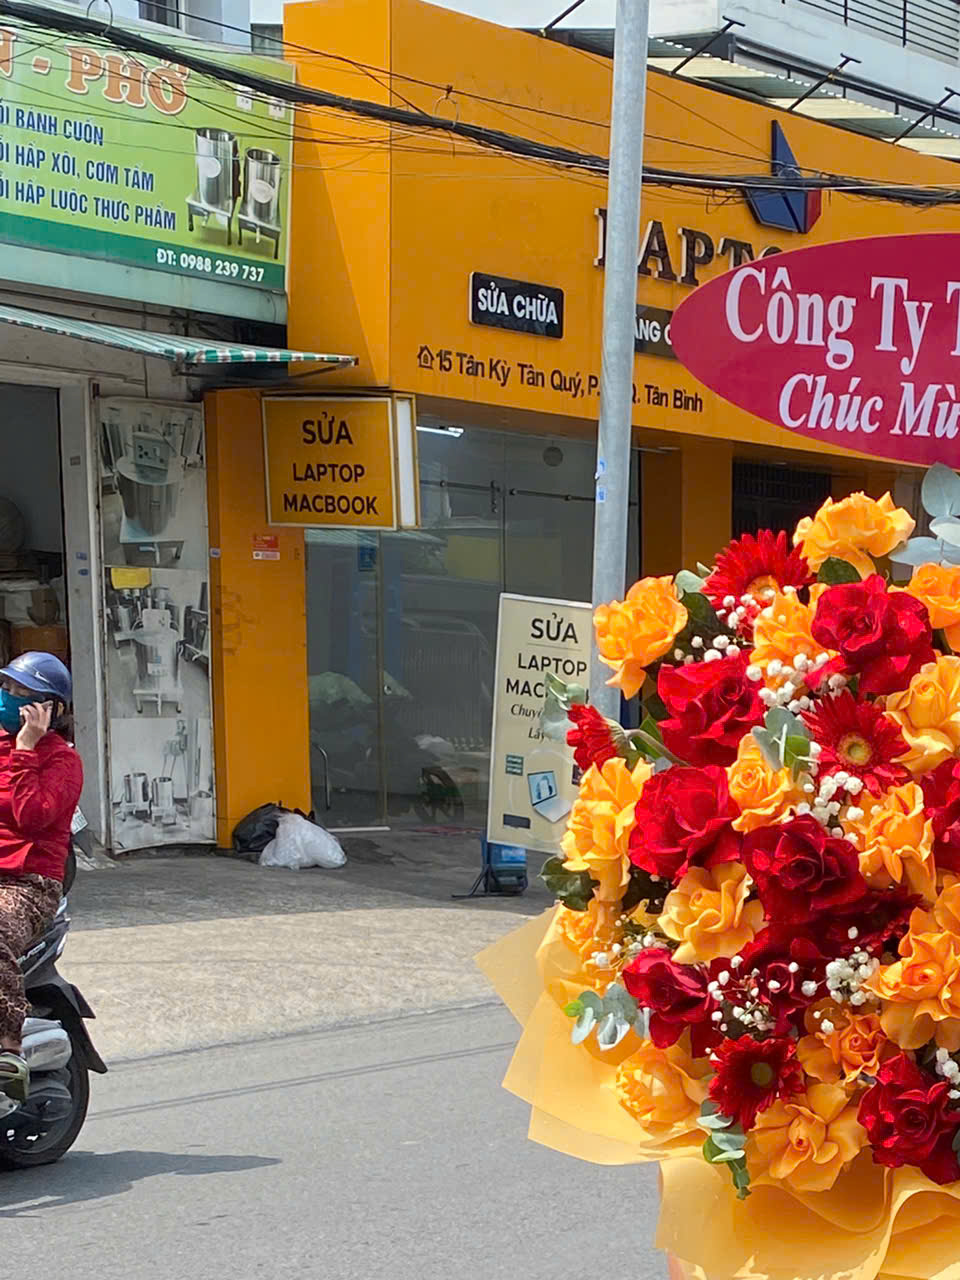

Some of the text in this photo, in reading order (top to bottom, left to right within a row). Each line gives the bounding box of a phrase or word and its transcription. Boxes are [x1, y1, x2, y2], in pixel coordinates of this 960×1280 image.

[86, 160, 119, 185] CƠM
[93, 197, 130, 225] THỰC
[157, 248, 264, 282] ĐT: 0988 239 737
[477, 282, 558, 325] SỬA CHỮA
[725, 266, 856, 370] Công
[870, 276, 933, 375] Ty
[436, 350, 452, 372] 15
[456, 352, 484, 377] Tân
[489, 358, 510, 387] Kỳ
[517, 362, 544, 387] Tân
[551, 370, 585, 397] Quý,
[644, 384, 668, 407] Tân
[673, 388, 703, 413] Bình
[779, 372, 883, 434] Chúc
[301, 411, 353, 446] SỬA
[292, 462, 366, 484] LAPTOP
[283, 493, 378, 516] MACBOOK
[530, 613, 579, 645] SỬA
[518, 652, 588, 677] LAPTOP
